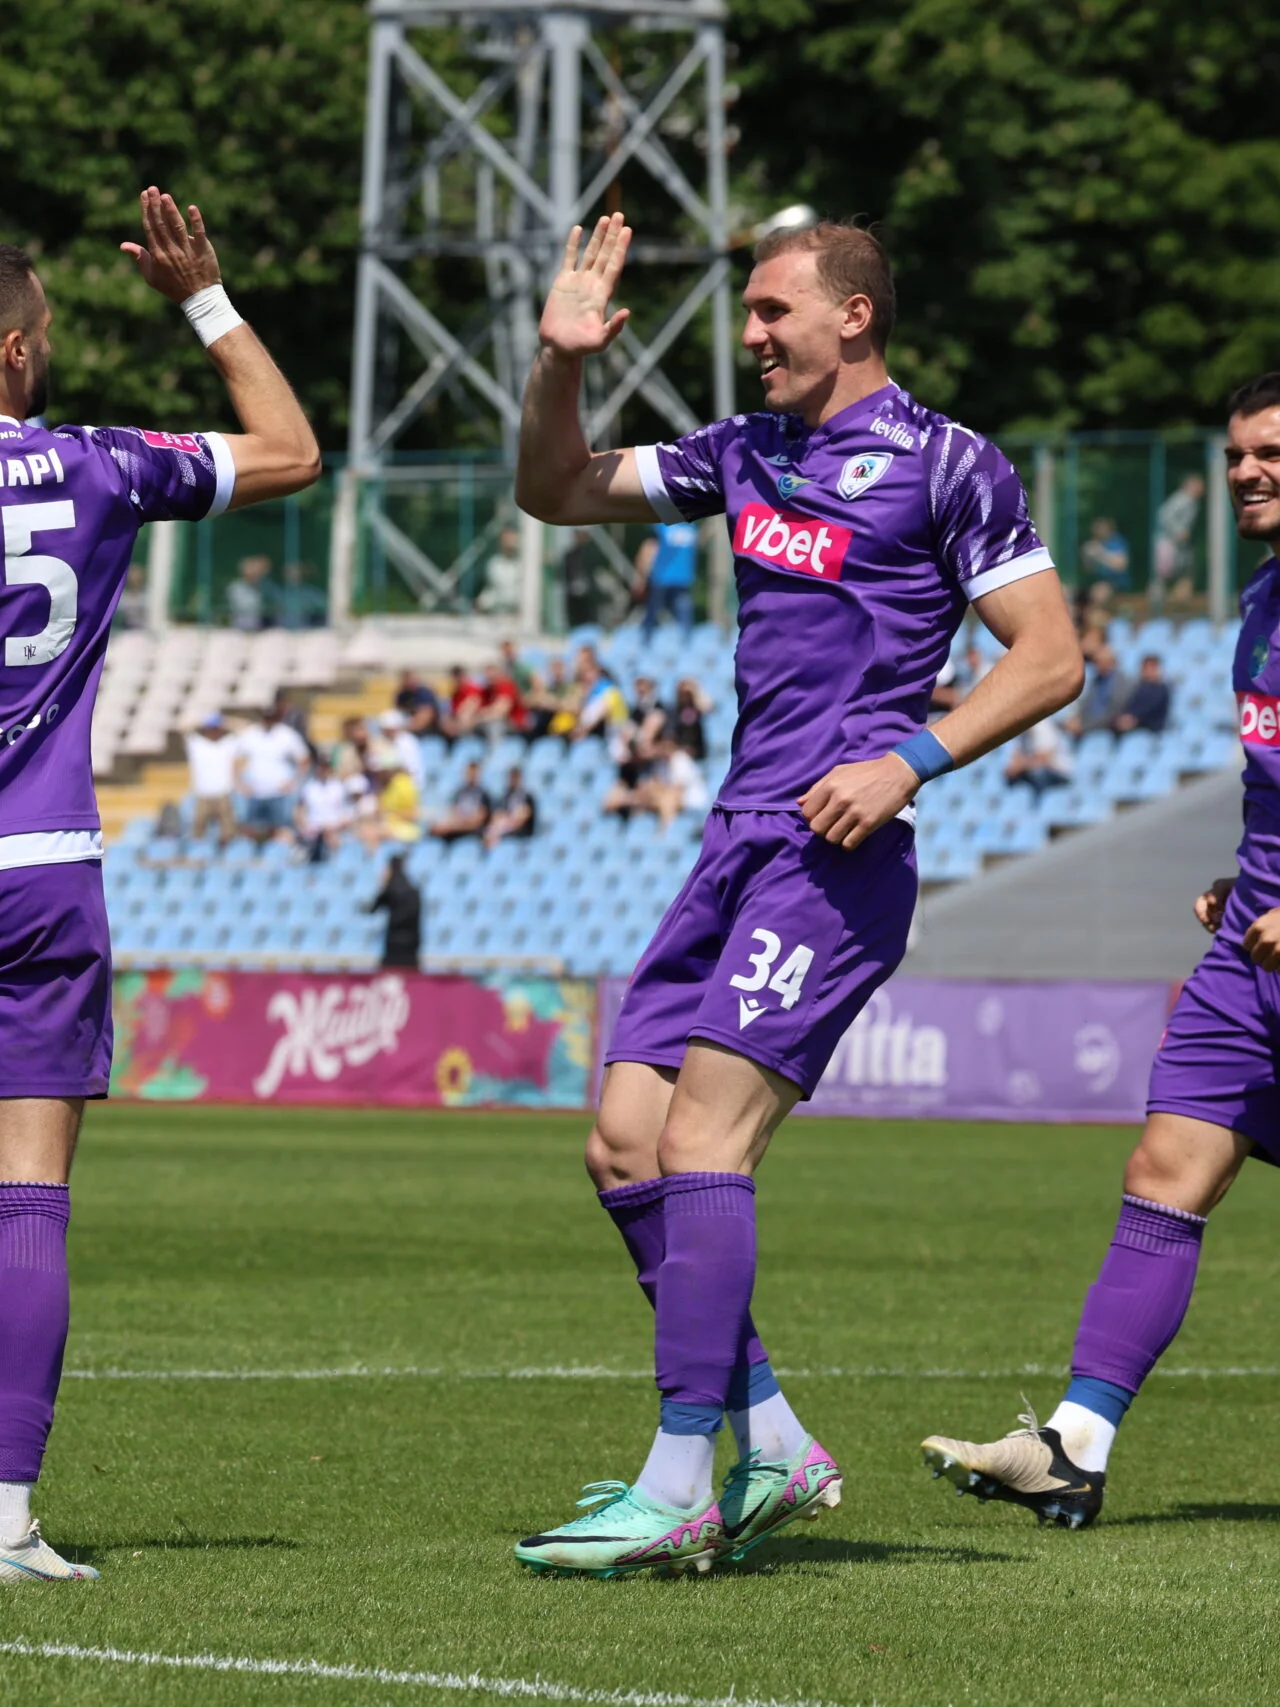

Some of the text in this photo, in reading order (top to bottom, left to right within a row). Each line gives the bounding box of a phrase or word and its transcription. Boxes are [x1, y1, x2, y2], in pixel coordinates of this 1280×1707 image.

[870, 416, 915, 450] tevitta
[742, 513, 833, 574] vbet
[729, 928, 815, 1011] 34
